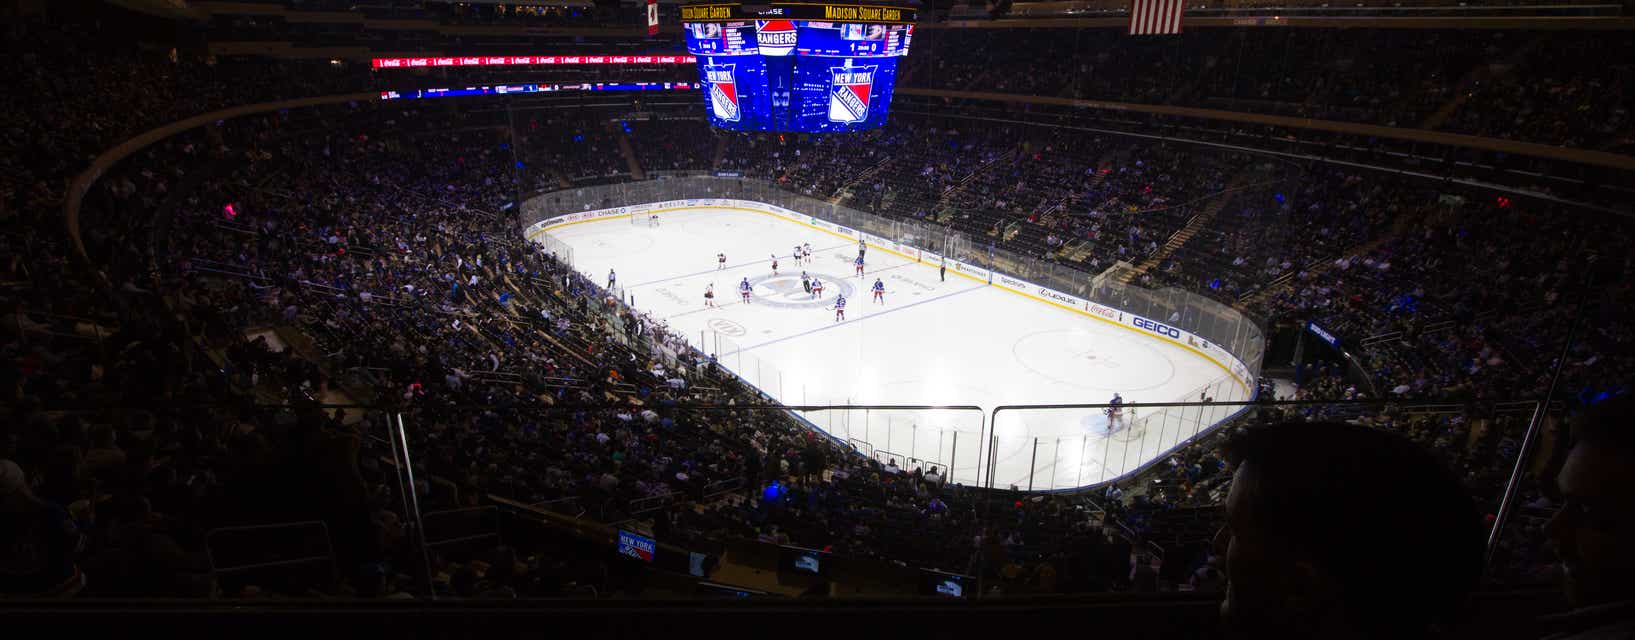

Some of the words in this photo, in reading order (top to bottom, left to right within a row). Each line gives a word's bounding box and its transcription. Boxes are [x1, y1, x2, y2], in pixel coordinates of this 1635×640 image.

[710, 6, 731, 19] GARDEN
[825, 5, 857, 19] MADISON
[859, 6, 881, 20] SQUARE
[882, 8, 901, 20] GARDEN
[757, 32, 797, 44] RANGERS
[707, 70, 717, 81] NEW
[717, 70, 733, 81] YORK
[834, 72, 852, 84] NEW
[853, 71, 872, 83] YORK
[713, 85, 738, 119] RANGERS
[837, 85, 866, 117] RANGERS
[598, 208, 619, 217] CHASE
[1047, 291, 1076, 305] LEXUS
[1132, 316, 1180, 339] GEICO
[620, 535, 635, 545] NEW
[635, 540, 653, 553] YORK
